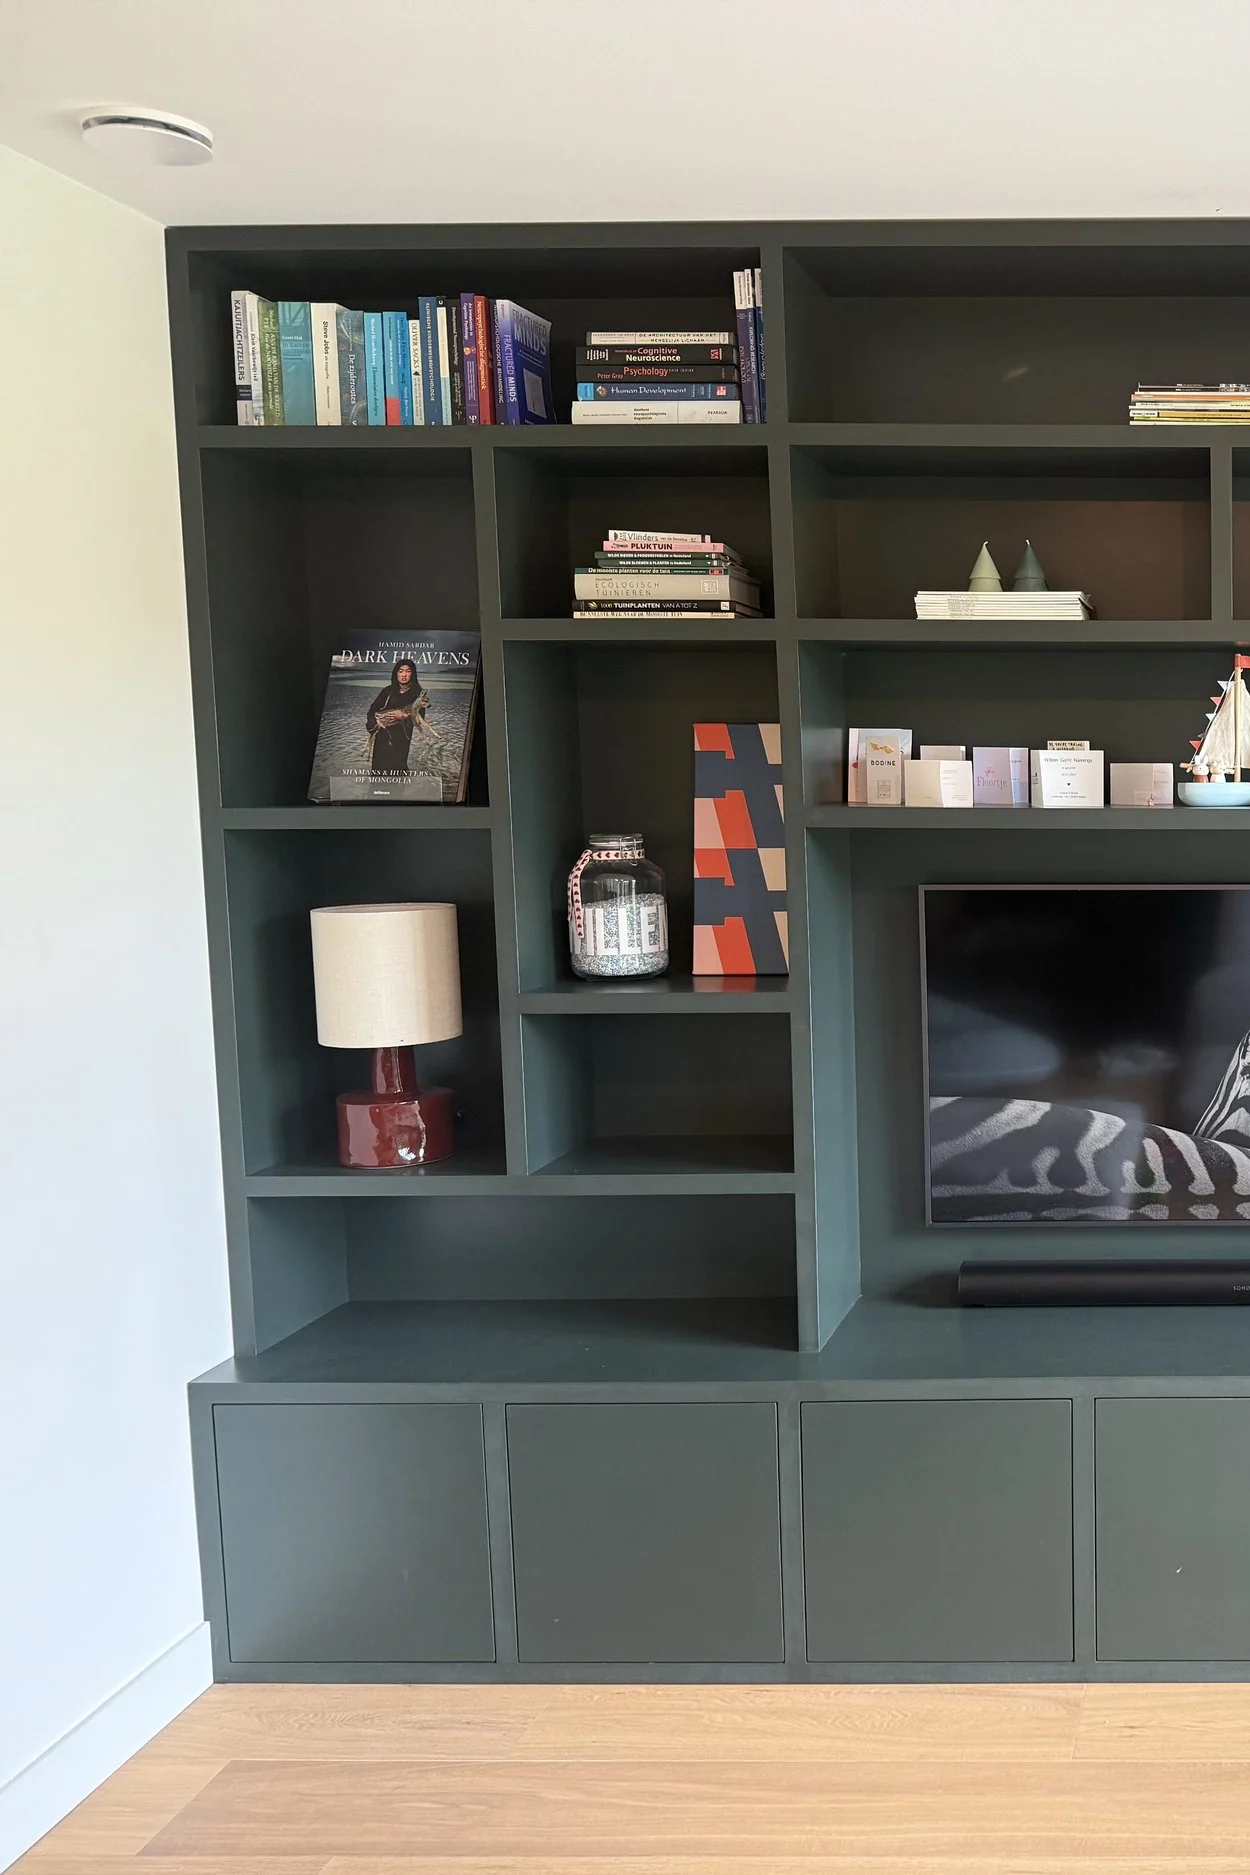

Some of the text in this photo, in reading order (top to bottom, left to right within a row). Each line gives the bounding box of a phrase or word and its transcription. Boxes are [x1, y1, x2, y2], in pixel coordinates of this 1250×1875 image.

[476, 301, 486, 358] Neuropsychologische
[512, 309, 546, 336] FRACTURED
[234, 299, 245, 381] KAJUITJACHTZEILERS
[411, 322, 419, 346] OLIVER
[514, 323, 547, 355] MINDS
[412, 348, 420, 369] SACKS
[625, 354, 681, 362] Neuroscience
[637, 347, 678, 356] Cognitive
[348, 354, 356, 364] De
[503, 334, 518, 402] FRACTURED MINDS
[623, 366, 669, 377] Psychology
[346, 364, 357, 404] zijderoutes
[612, 373, 624, 381] Gray
[496, 367, 504, 404] BEHANDELING
[611, 386, 687, 396] Human Development
[627, 532, 659, 541] Vlinders
[595, 581, 660, 589] ECOLOGISCH
[595, 589, 651, 597] TUINIEREN
[340, 649, 470, 666] DARK HEAVENS
[390, 769, 428, 777] HUNTERS
[976, 776, 1008, 790] Floortje
